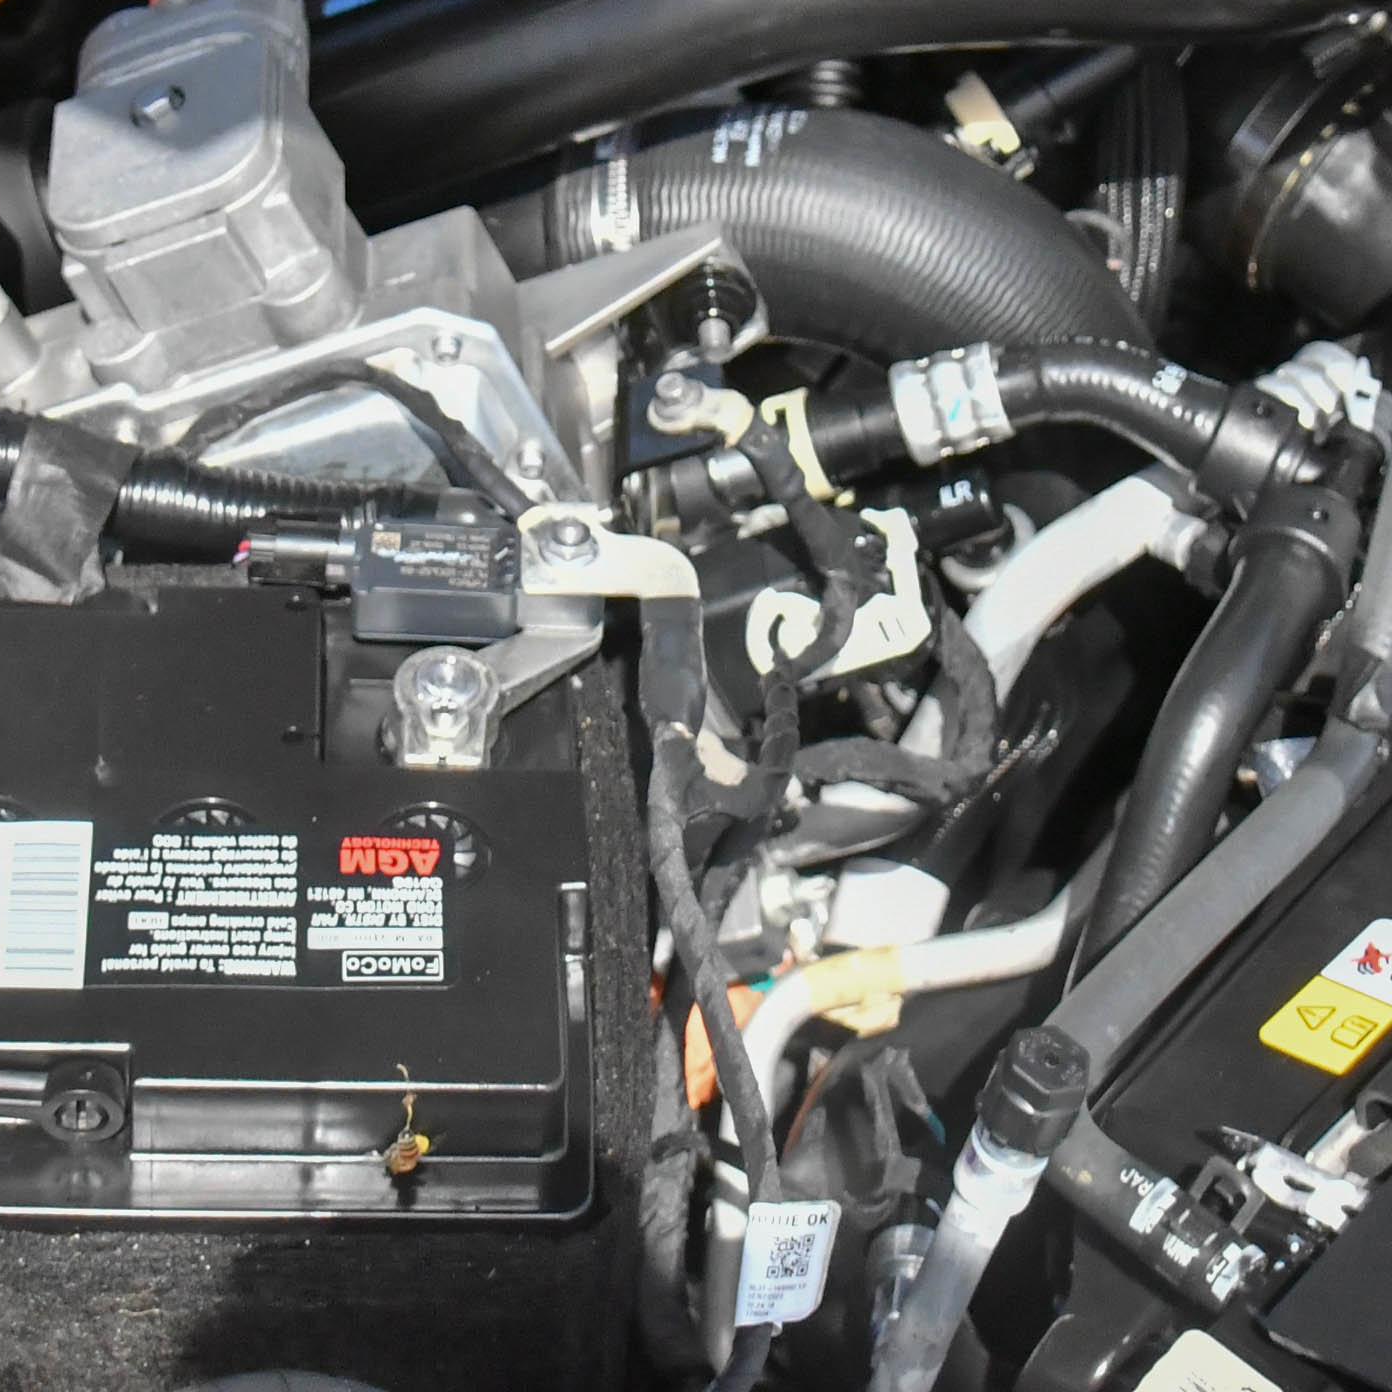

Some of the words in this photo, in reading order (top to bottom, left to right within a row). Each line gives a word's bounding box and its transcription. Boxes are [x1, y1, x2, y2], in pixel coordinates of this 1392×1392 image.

[340, 836, 440, 849] TECHNOLOGY
[339, 848, 440, 876] AGM
[101, 956, 159, 973] personal
[346, 956, 440, 975] FoMoCo
